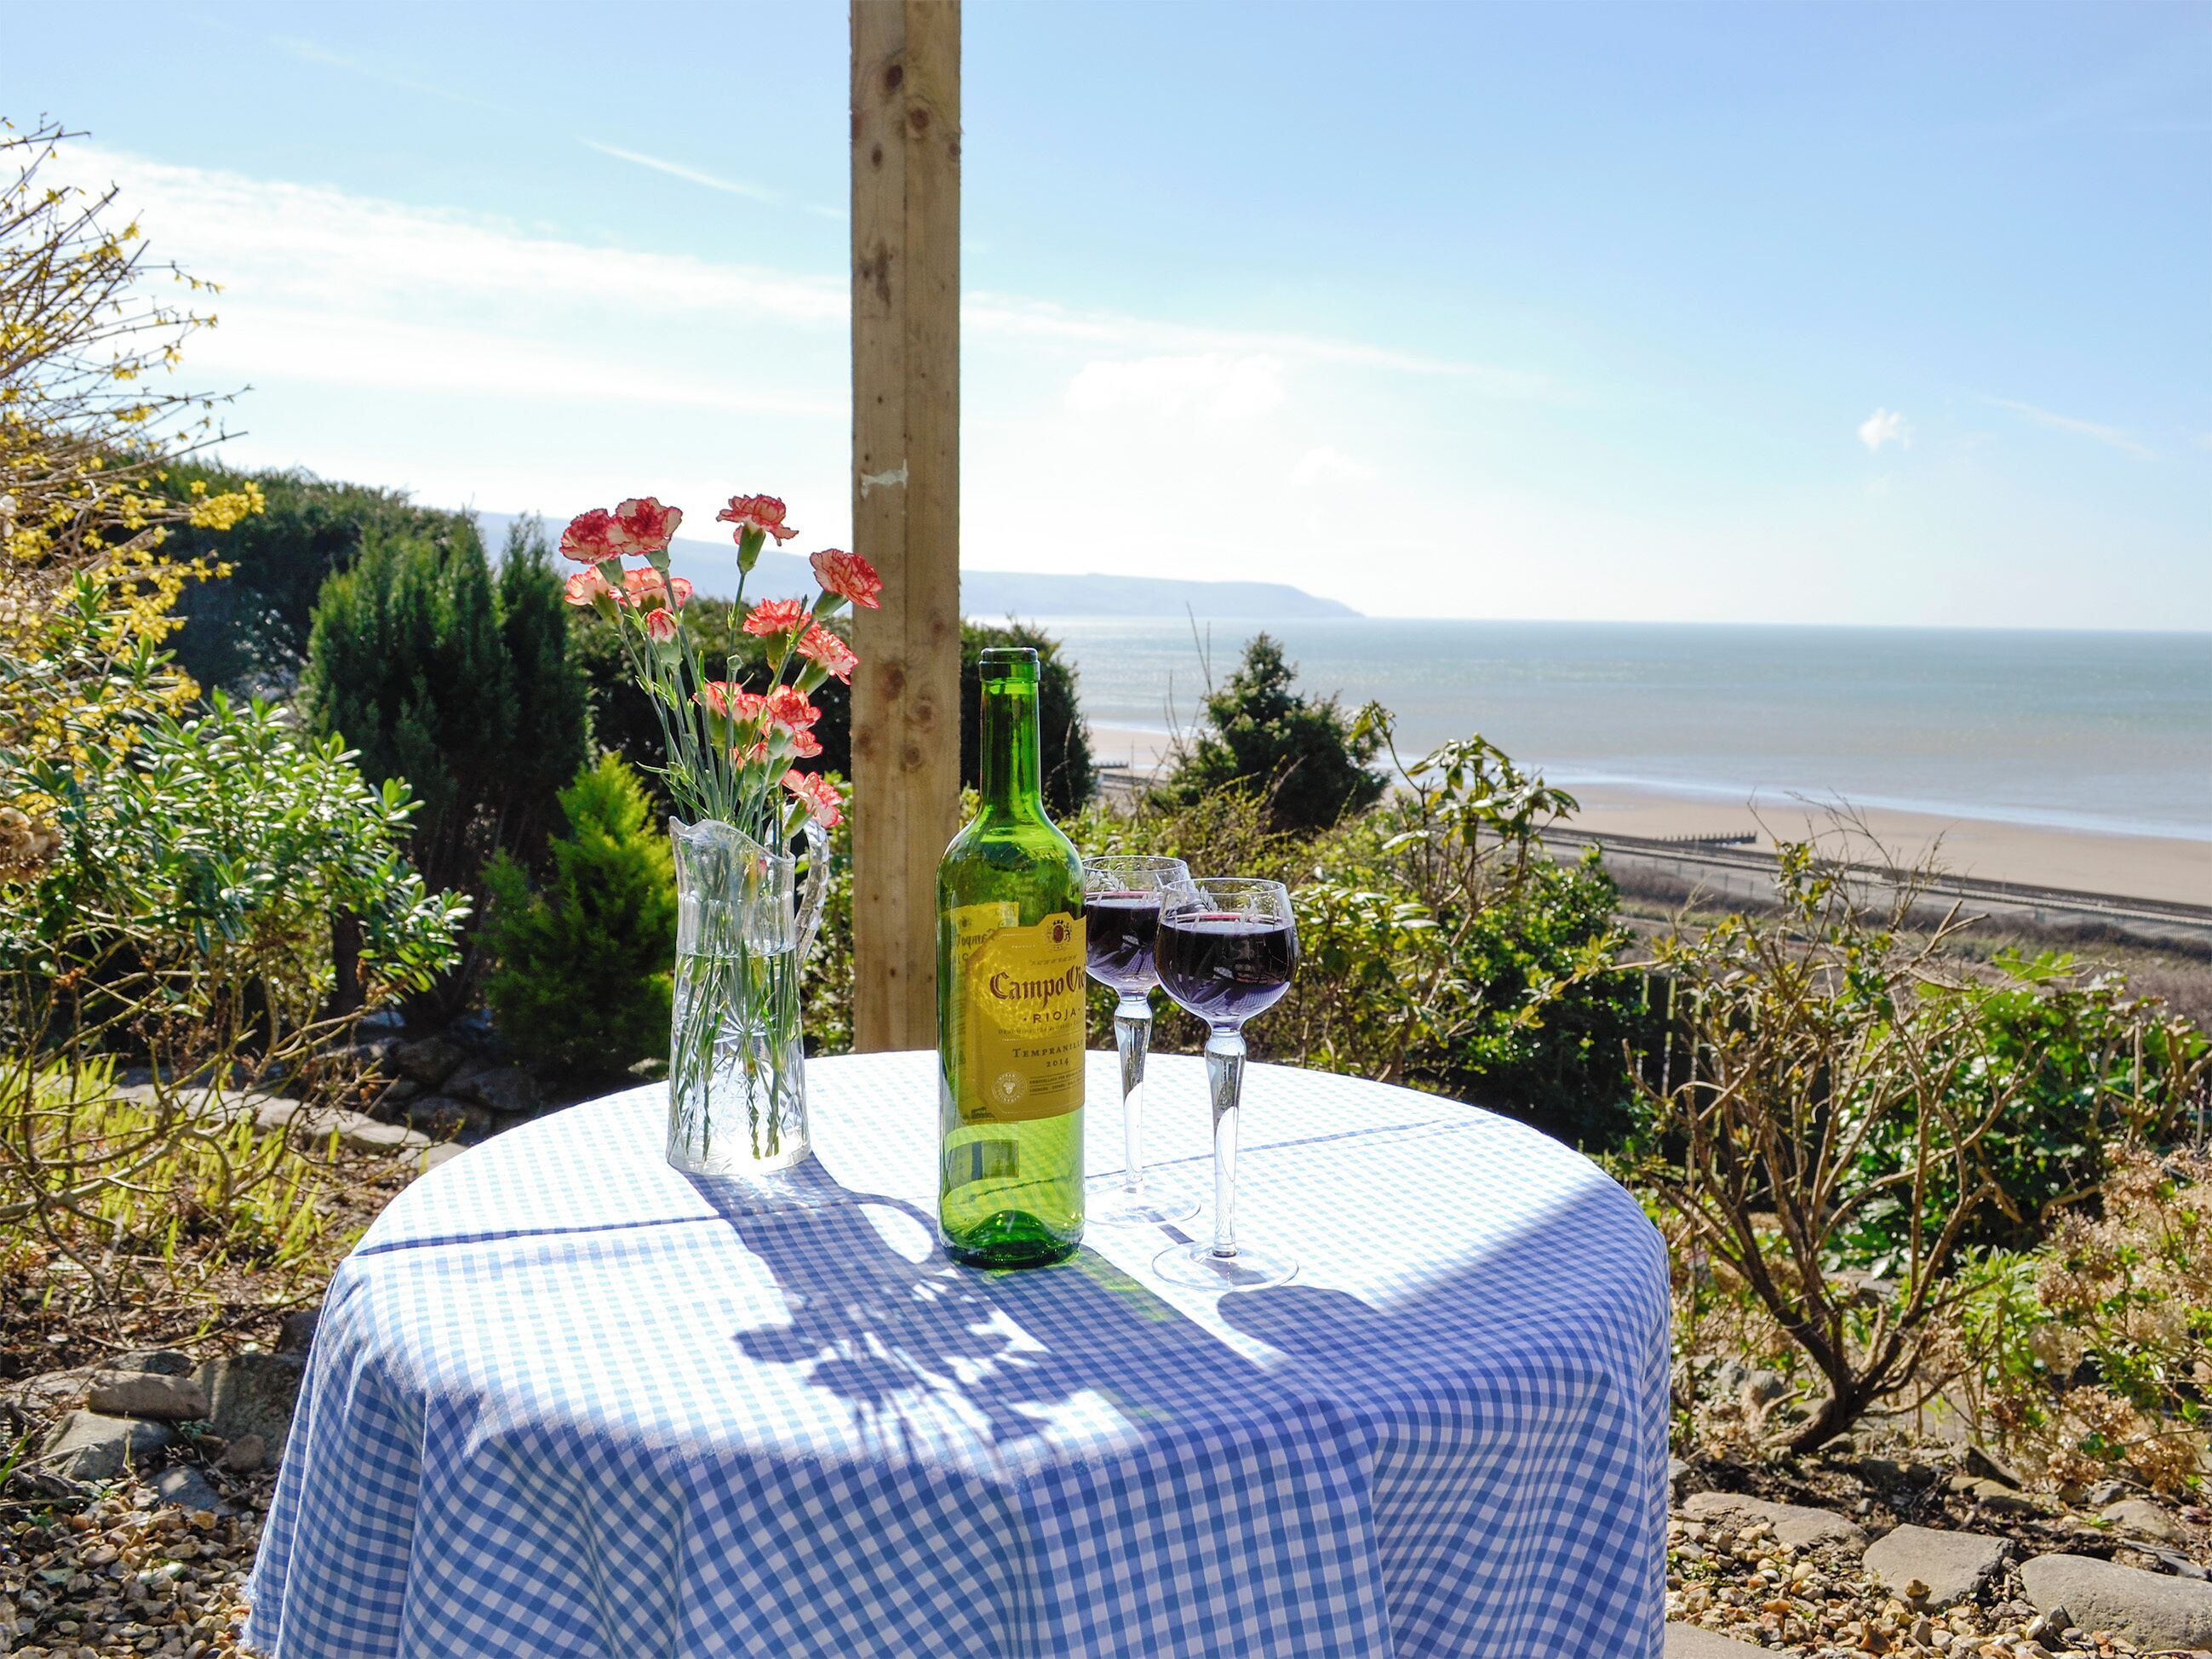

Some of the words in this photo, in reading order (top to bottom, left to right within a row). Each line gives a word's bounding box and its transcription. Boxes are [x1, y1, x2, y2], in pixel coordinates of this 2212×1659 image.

[989, 971, 1064, 1009] Campo
[1033, 1008, 1076, 1024] RIOJA
[1046, 1057, 1069, 1067] 2014
